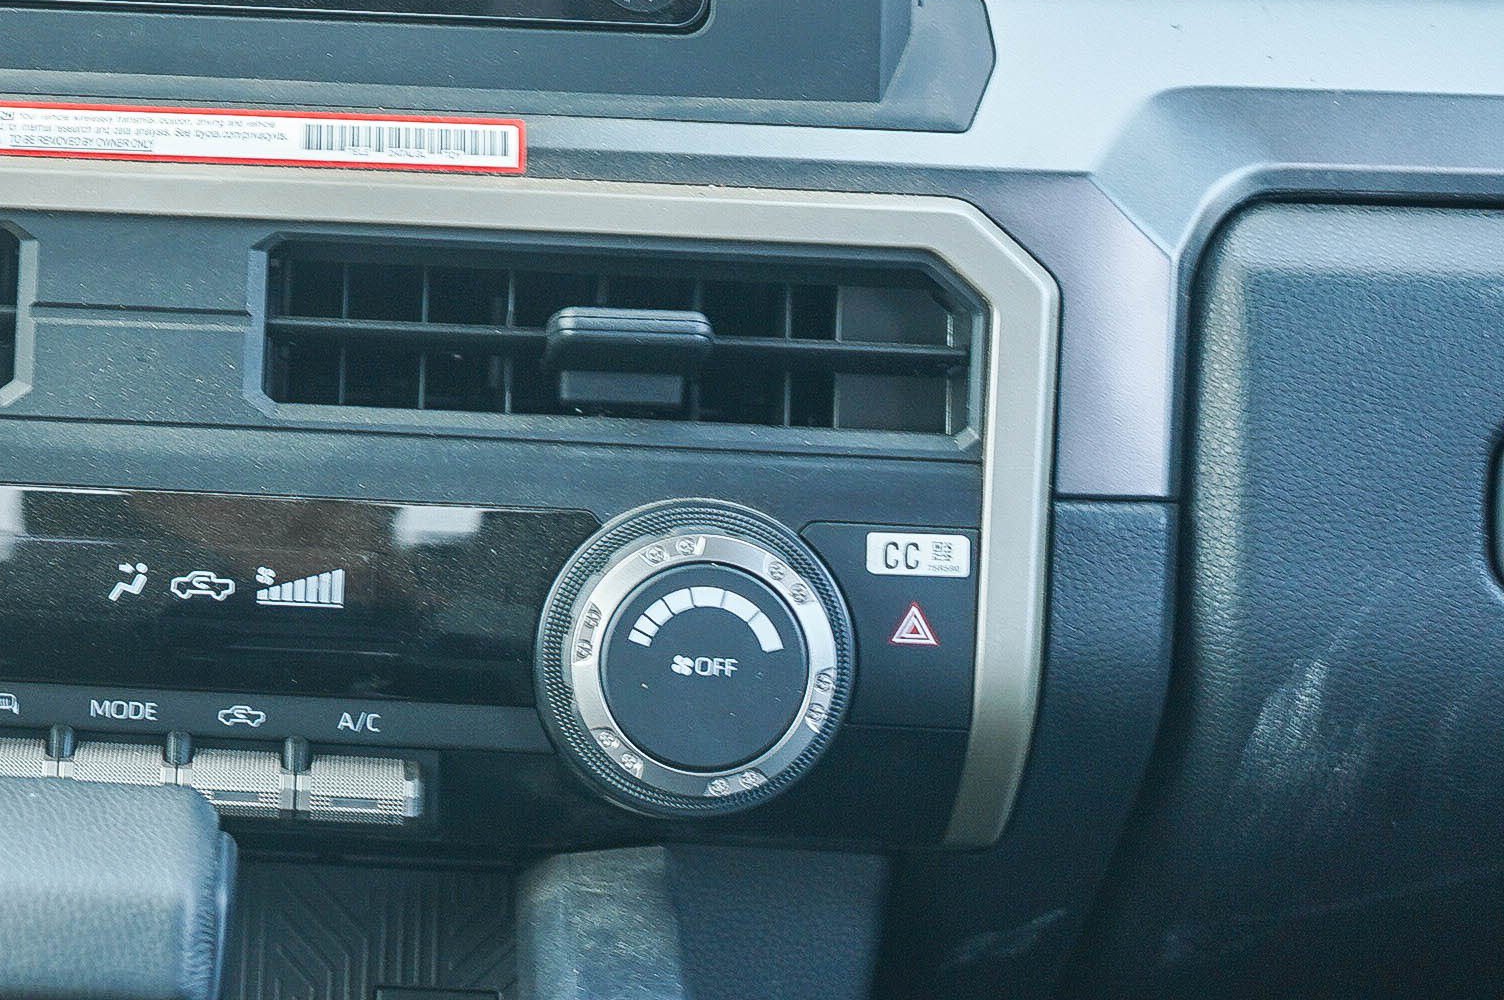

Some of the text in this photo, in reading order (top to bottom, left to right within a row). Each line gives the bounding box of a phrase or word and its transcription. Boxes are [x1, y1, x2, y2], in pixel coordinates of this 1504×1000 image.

[695, 656, 739, 678] OFF
[89, 699, 159, 721] MODE
[337, 711, 382, 733] A/C
